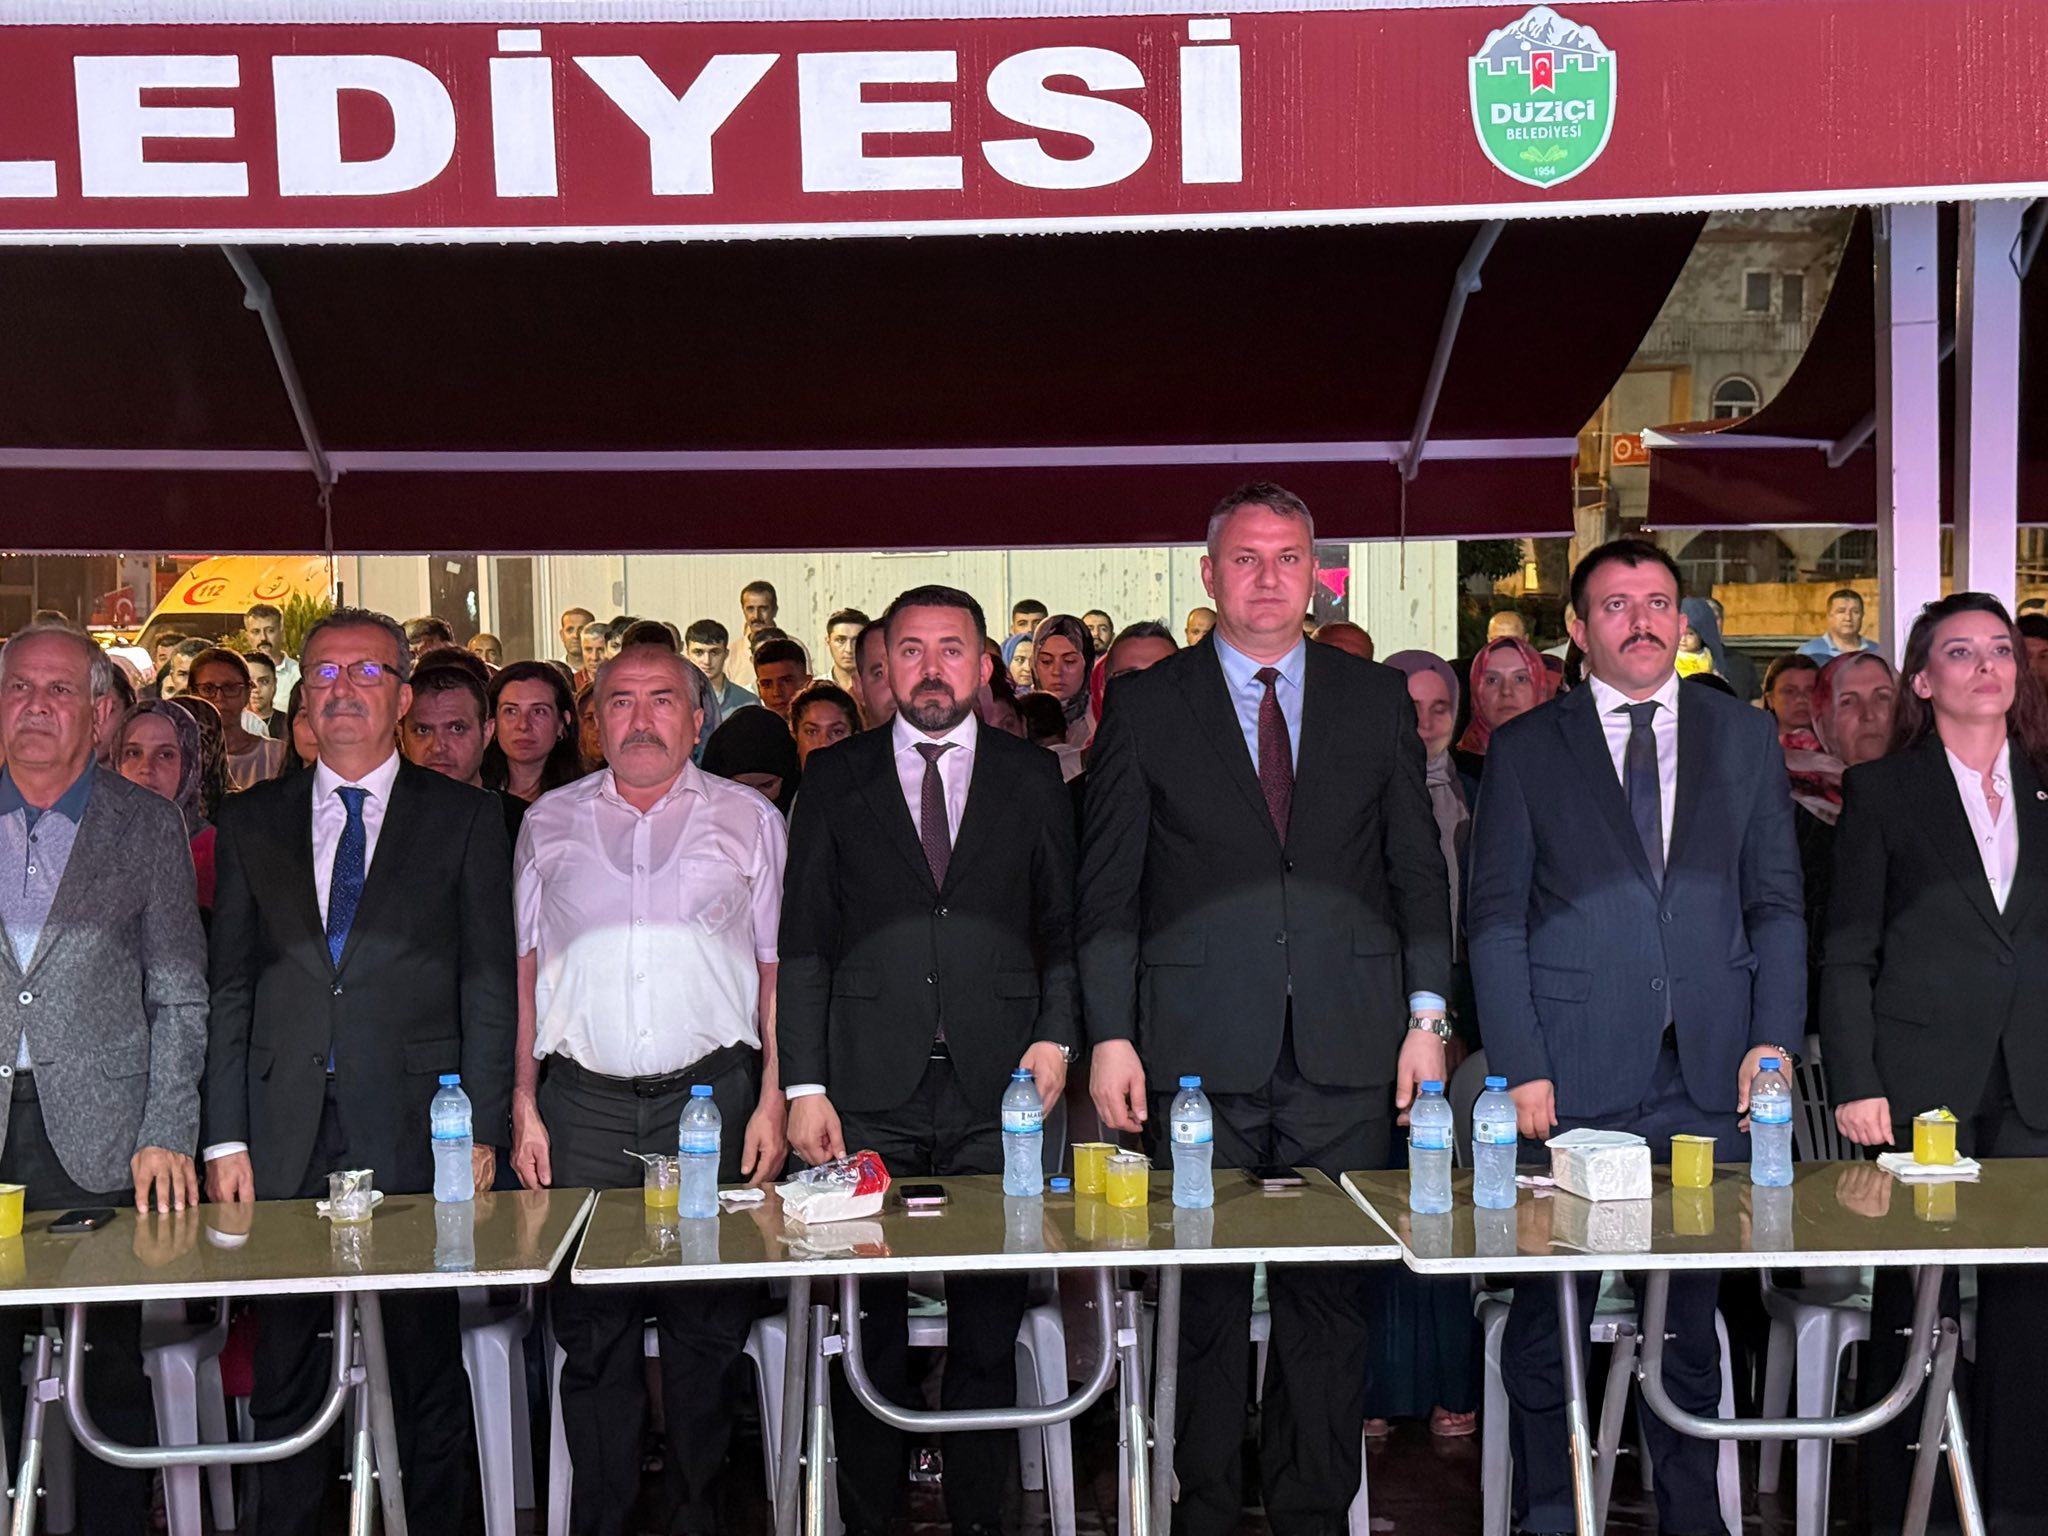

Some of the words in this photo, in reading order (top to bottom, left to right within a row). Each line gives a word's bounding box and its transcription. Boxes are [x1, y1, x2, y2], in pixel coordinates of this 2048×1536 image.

[1490, 99, 1595, 124] DÜZİÇİ
[1506, 126, 1582, 140] BELEDİYESİ
[1533, 166, 1556, 177] 1954
[199, 584, 225, 597] 112
